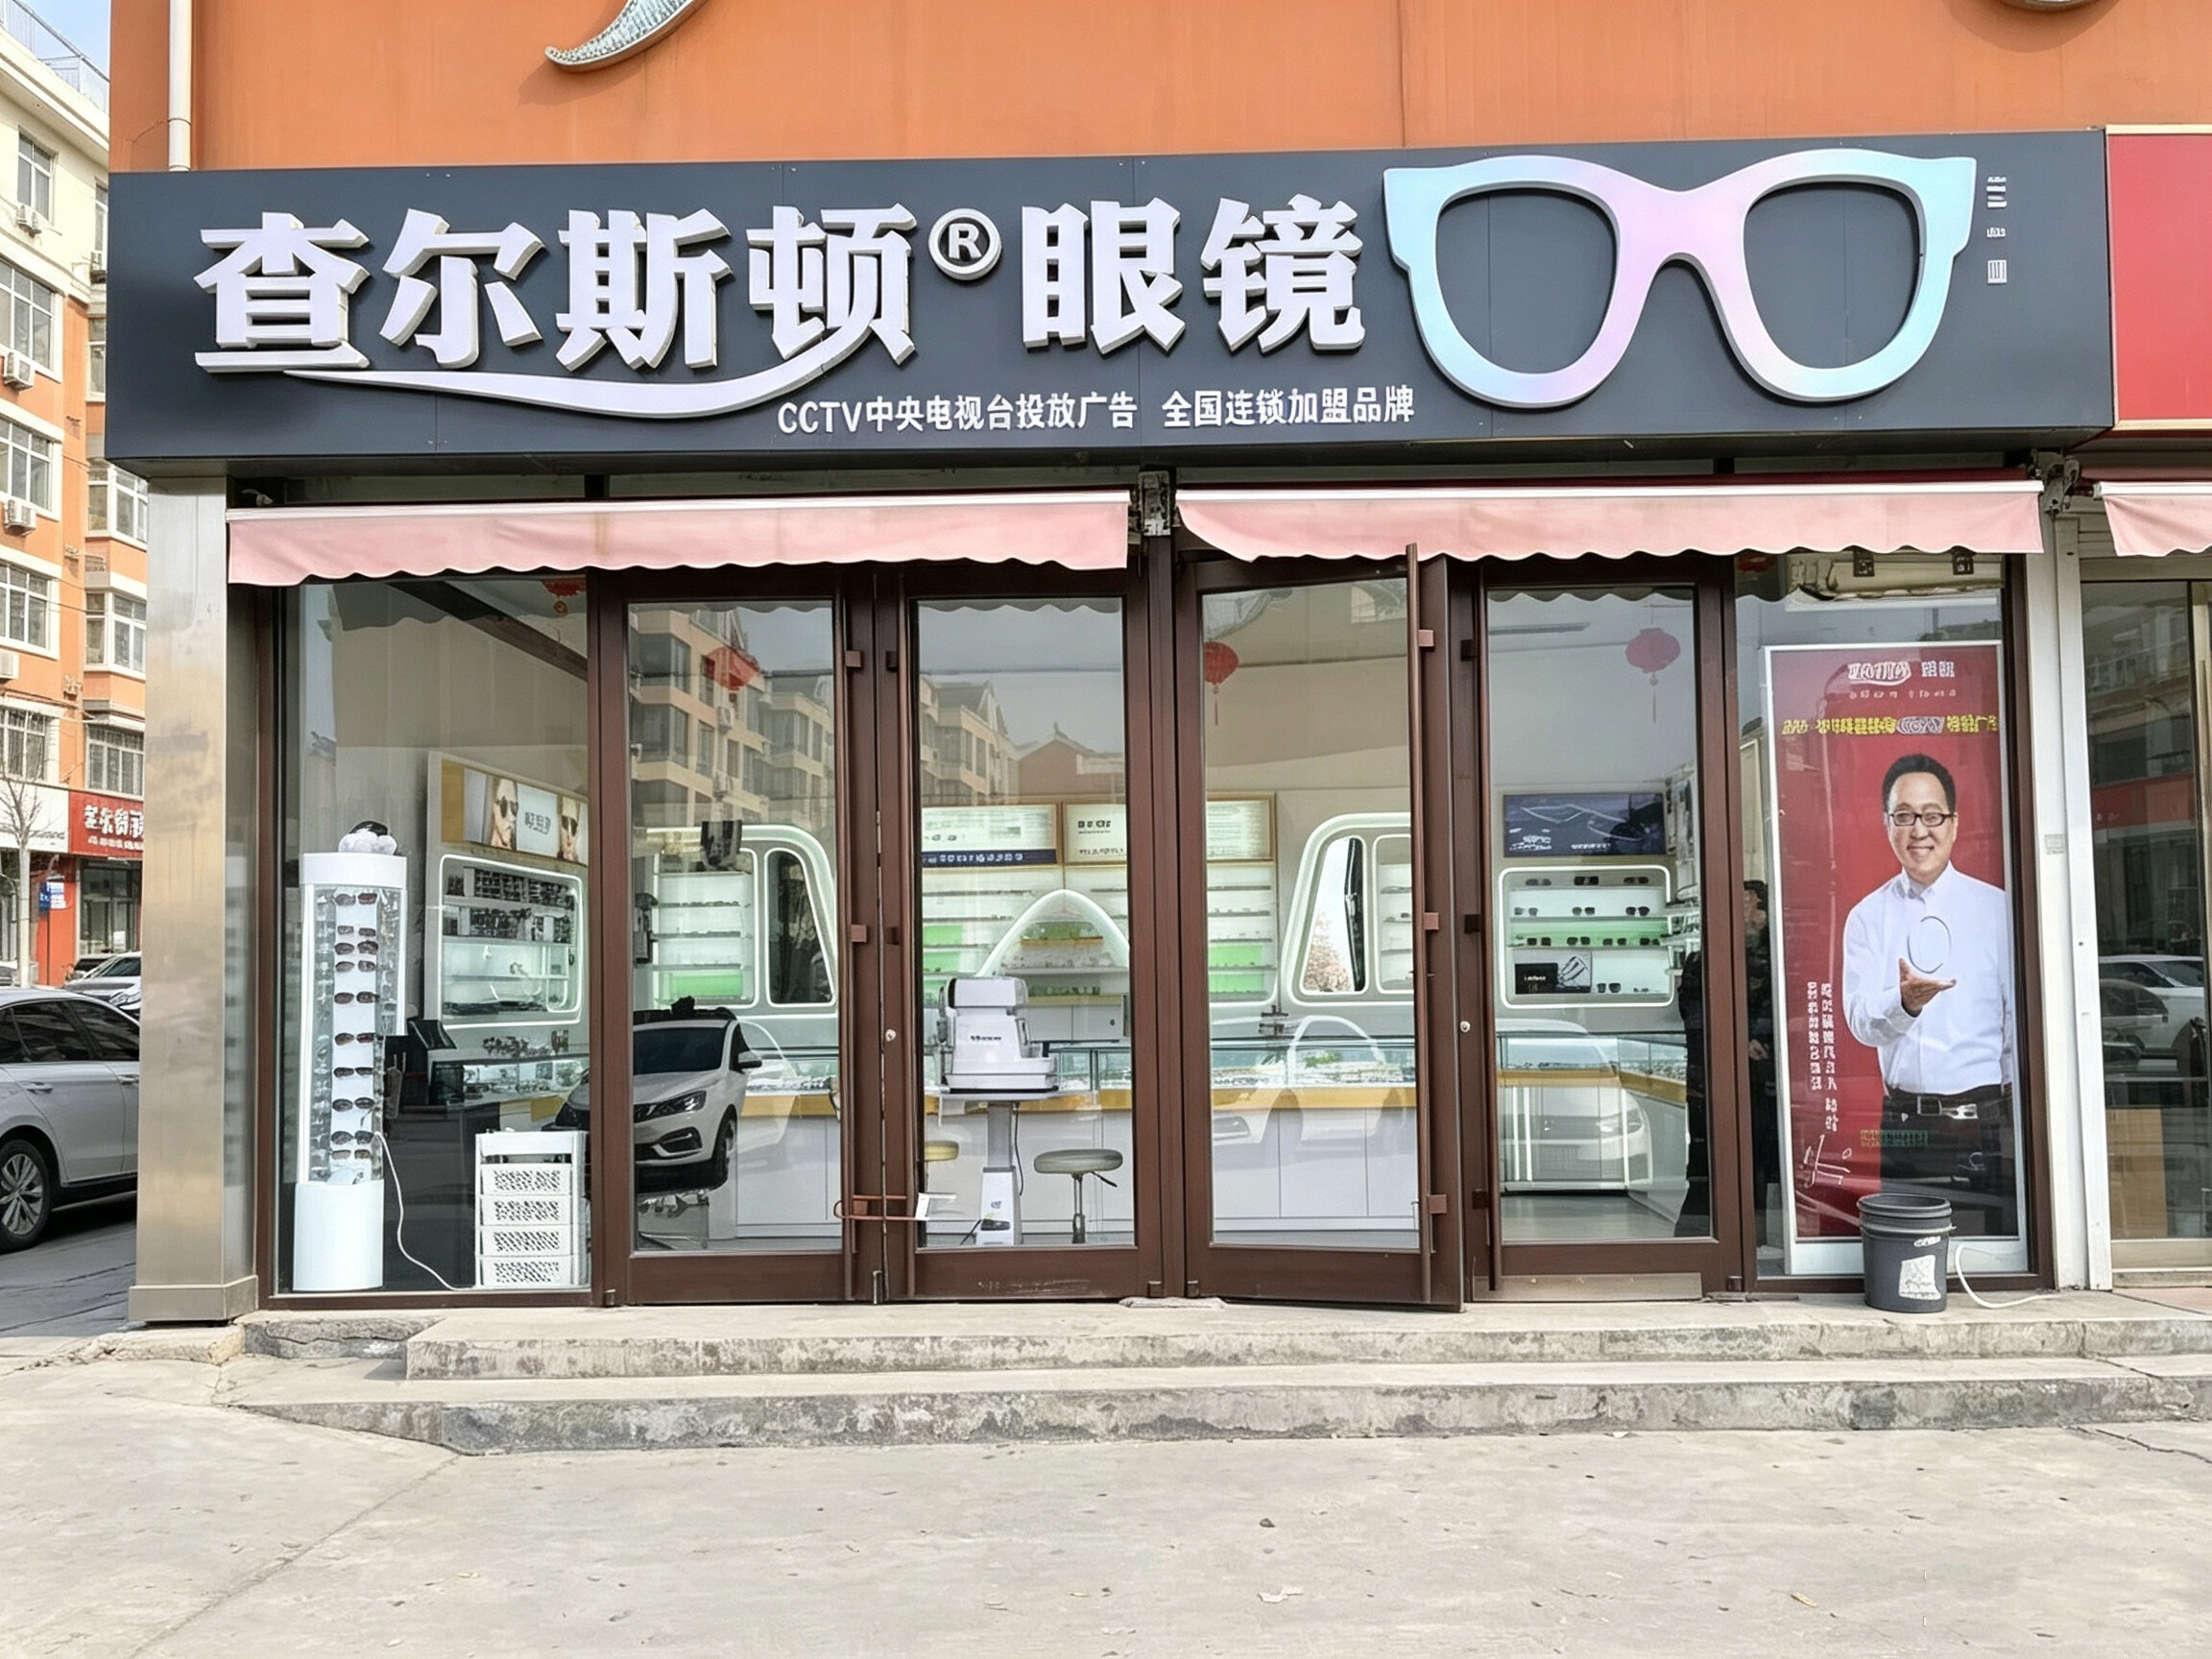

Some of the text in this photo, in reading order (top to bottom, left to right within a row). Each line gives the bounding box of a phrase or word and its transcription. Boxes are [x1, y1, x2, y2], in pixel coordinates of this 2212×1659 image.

[778, 385, 1414, 434] CCTV中央电视台投放广告 全国连锁加盟品牌
